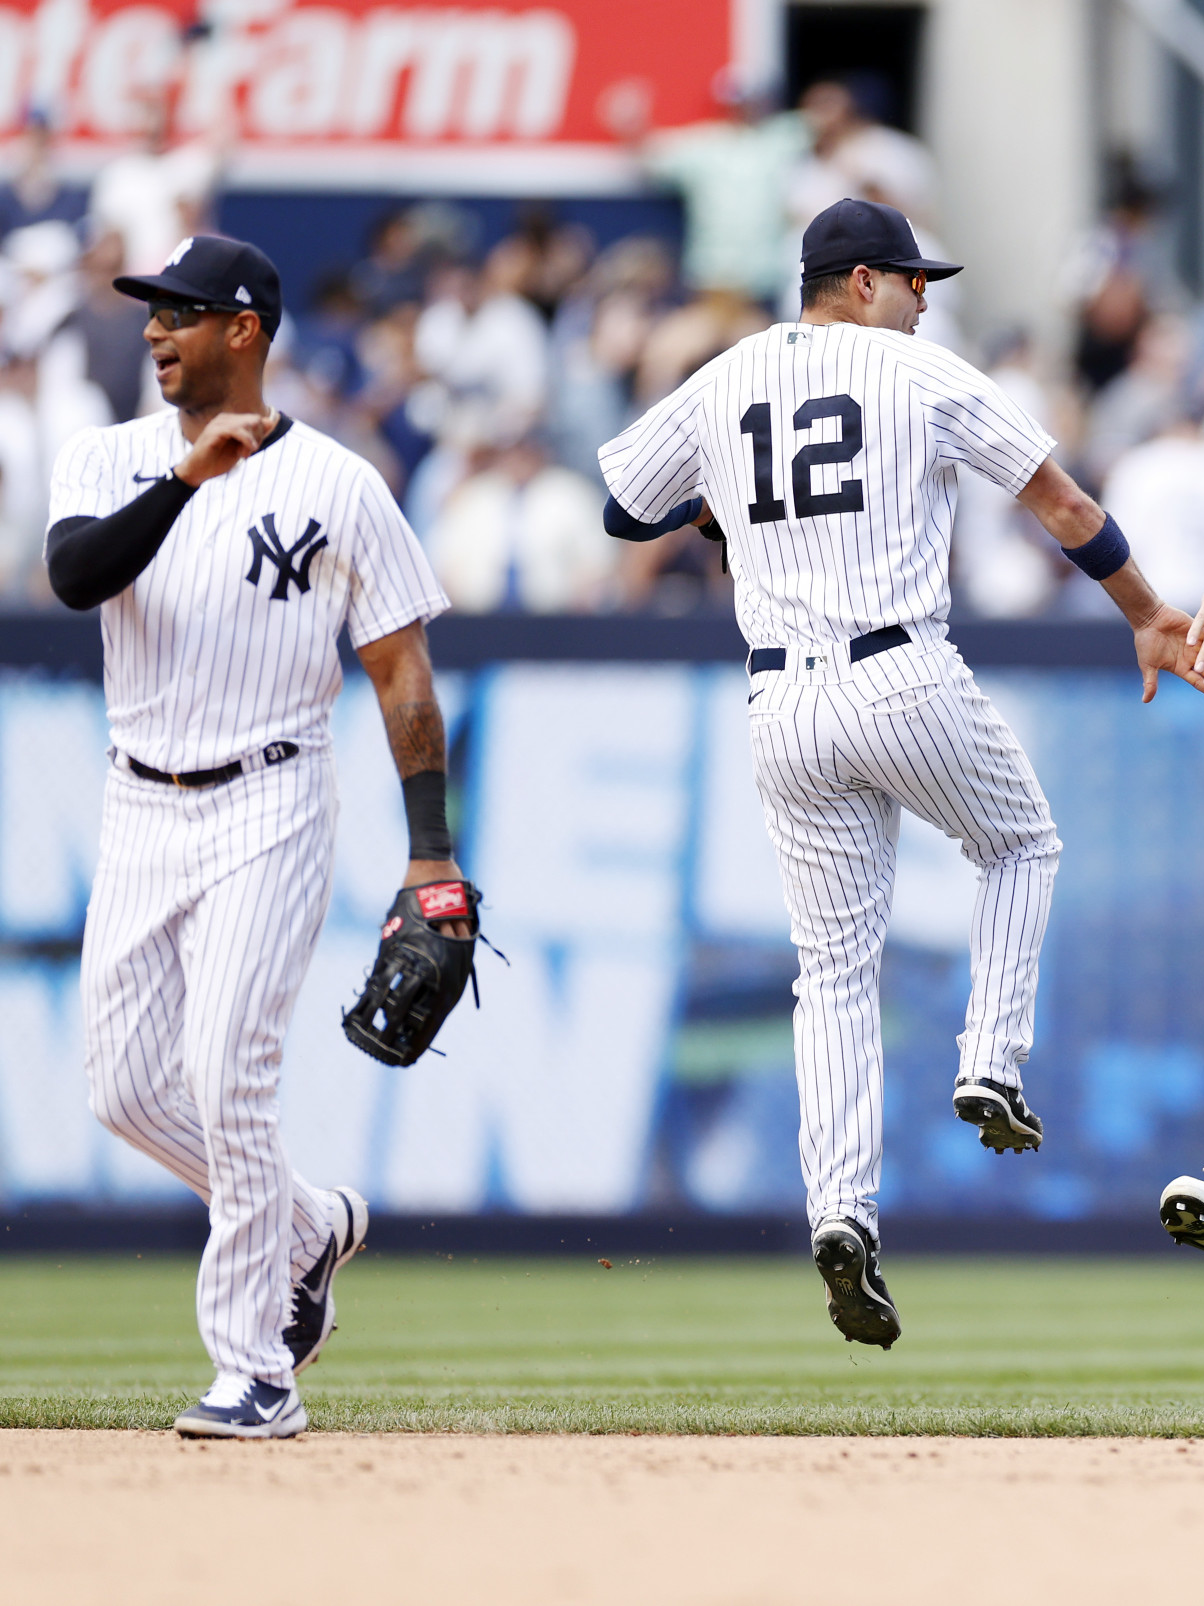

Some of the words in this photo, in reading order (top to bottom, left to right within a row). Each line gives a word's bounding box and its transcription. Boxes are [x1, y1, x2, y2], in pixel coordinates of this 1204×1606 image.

[740, 393, 864, 525] 12
[246, 512, 329, 601] NY
[266, 743, 286, 761] 31
